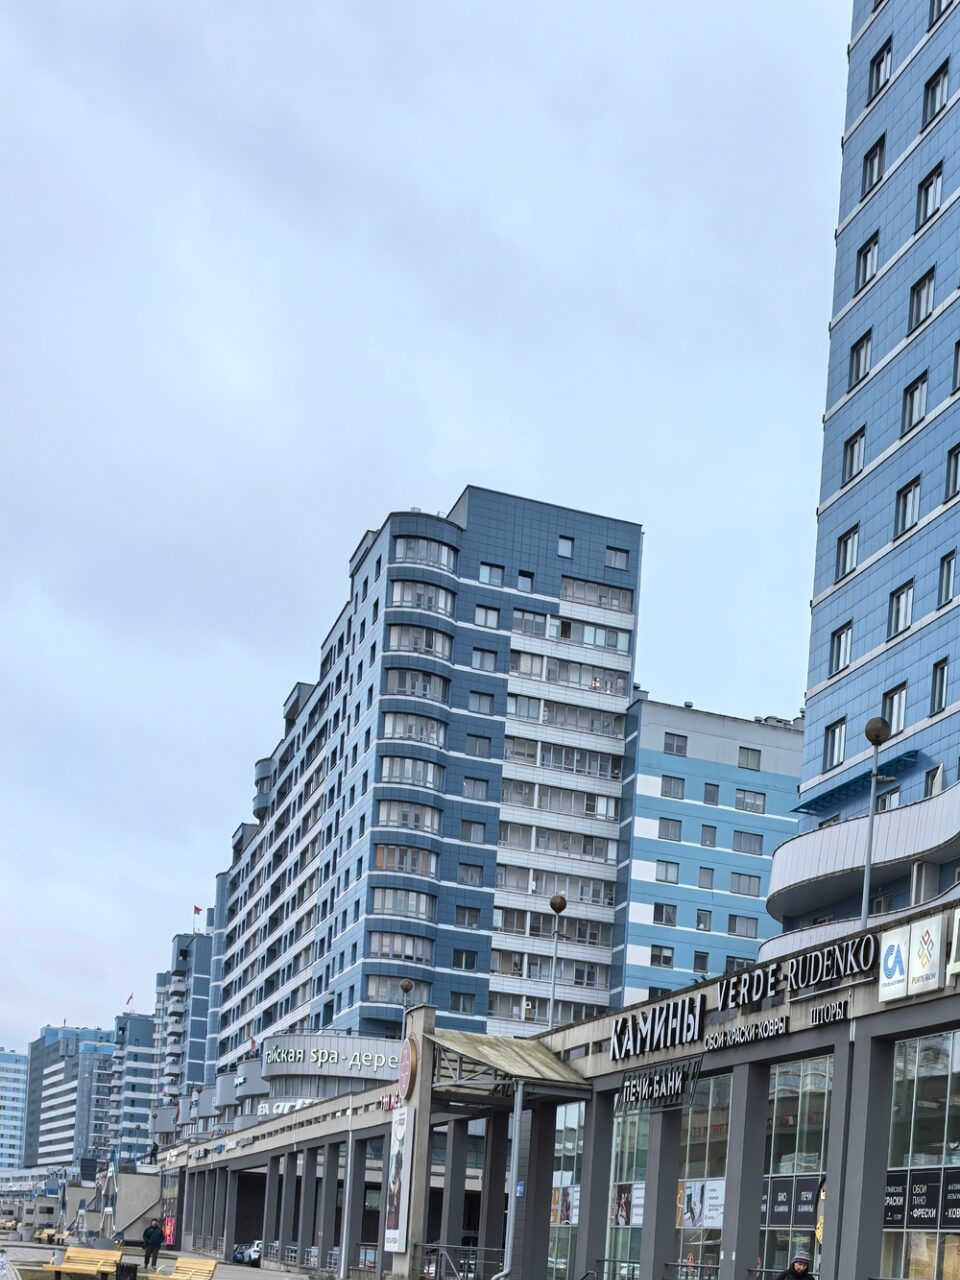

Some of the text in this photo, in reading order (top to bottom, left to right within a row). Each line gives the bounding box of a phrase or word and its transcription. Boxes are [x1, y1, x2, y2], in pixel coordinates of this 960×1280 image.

[718, 963, 779, 1012] VERDE
[787, 933, 879, 991] RUDENKO
[609, 994, 702, 1061] КАМИНЫ
[810, 1000, 846, 1026] ШТОРЫ
